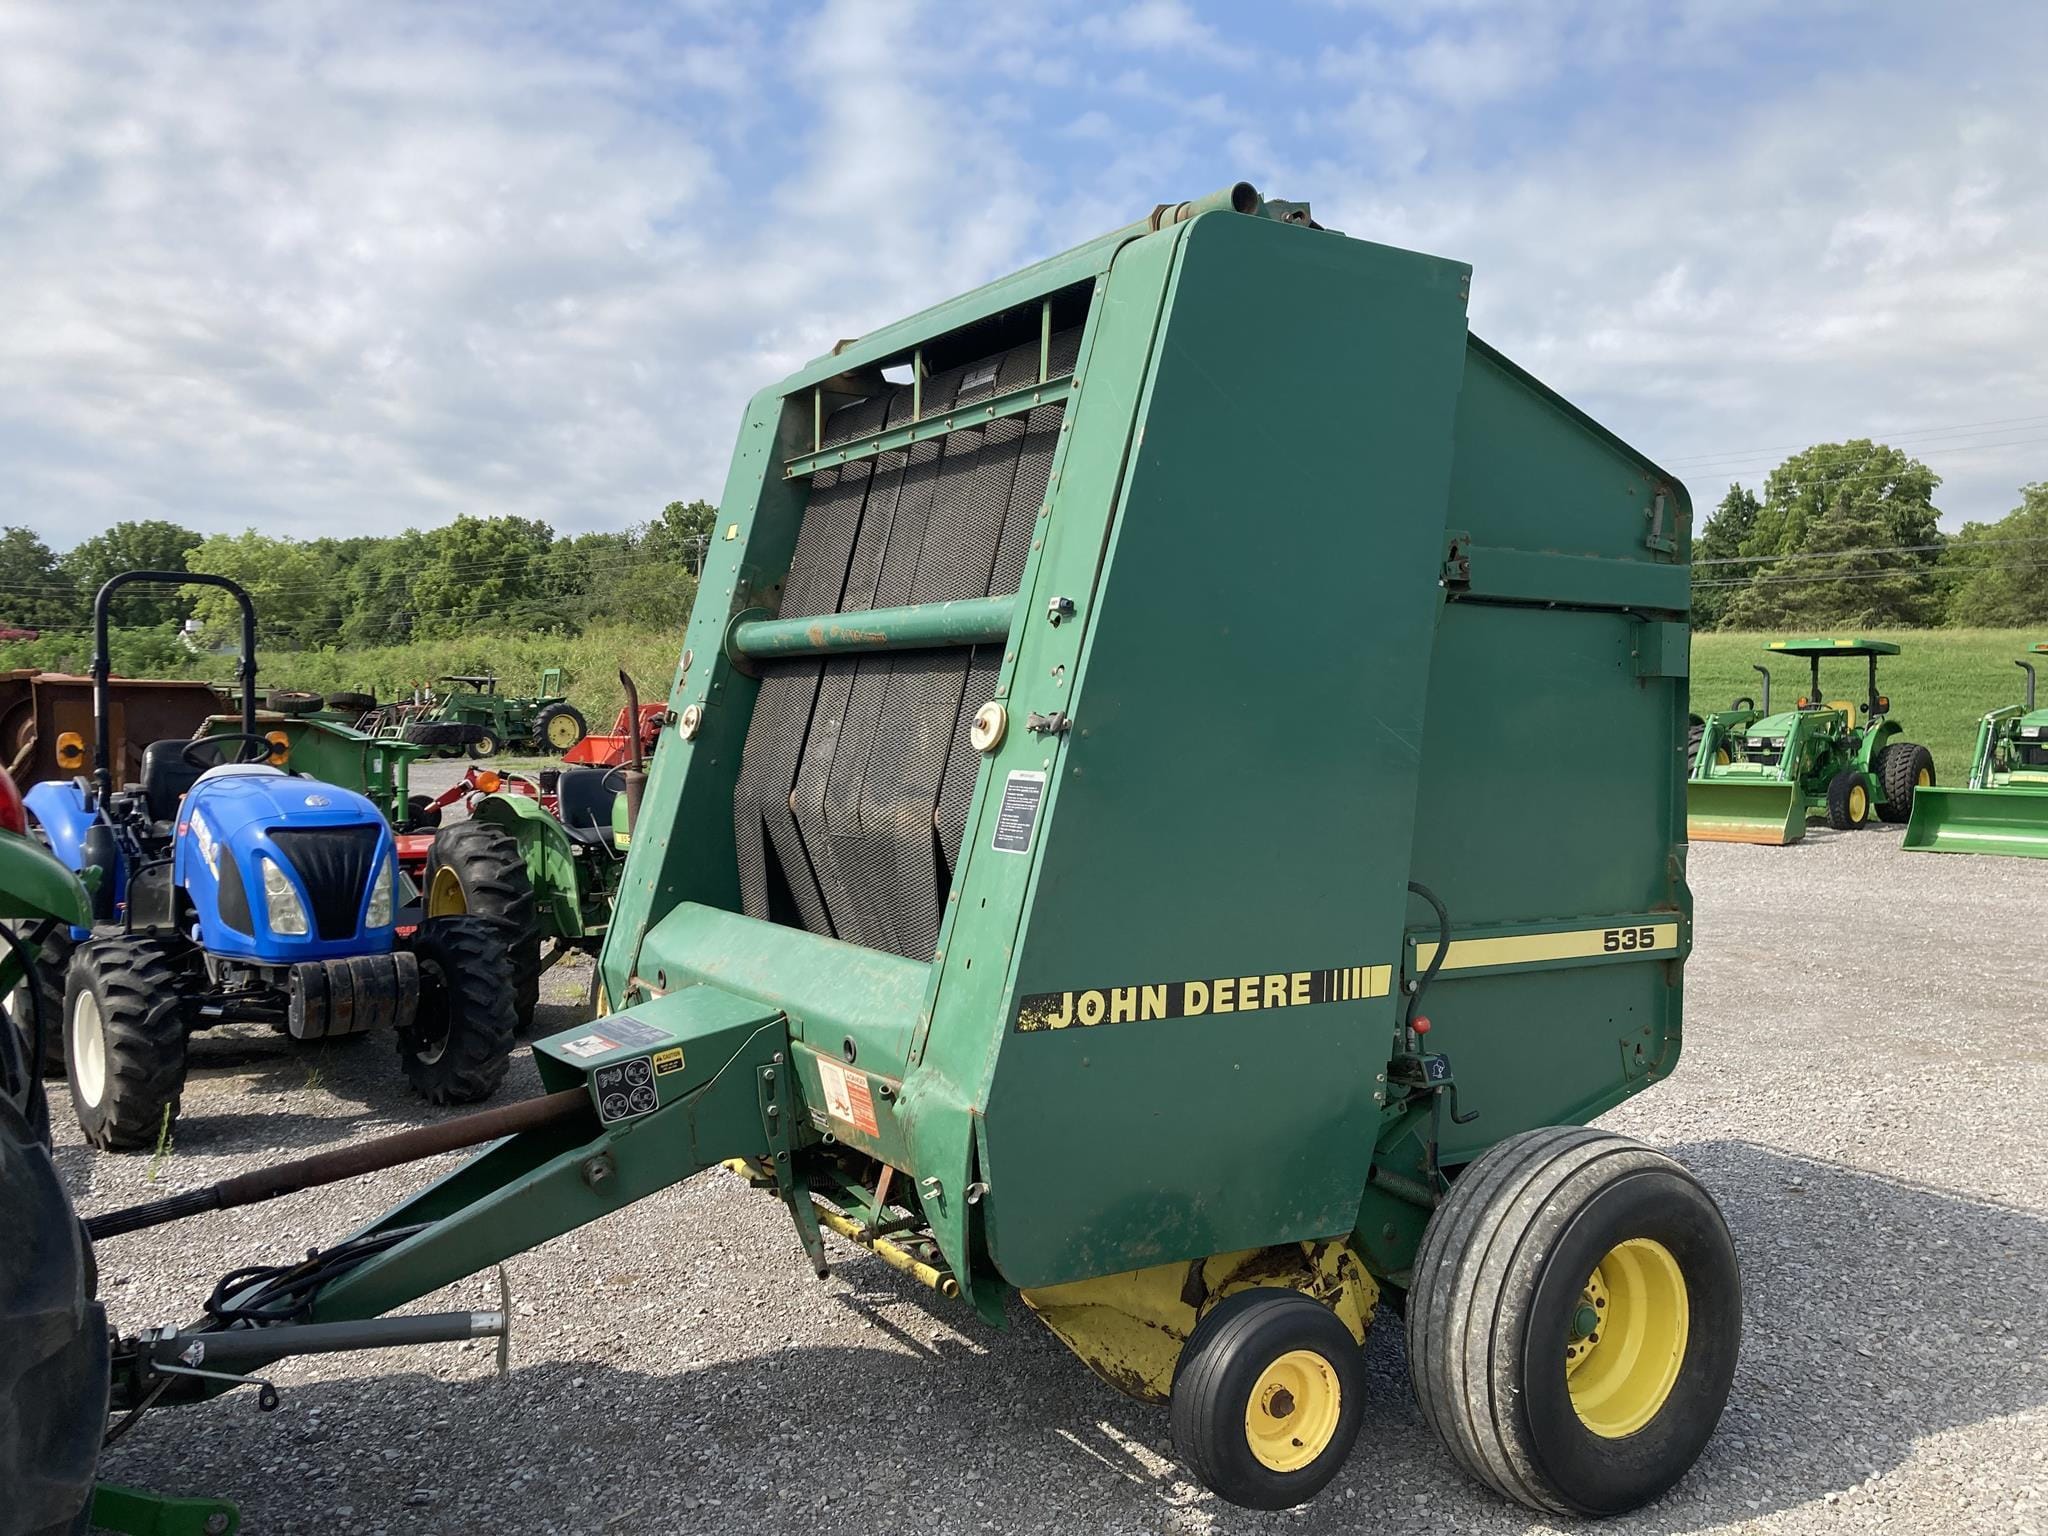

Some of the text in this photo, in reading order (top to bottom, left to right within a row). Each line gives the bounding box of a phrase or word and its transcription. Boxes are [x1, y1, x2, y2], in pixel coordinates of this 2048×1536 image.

[1603, 927, 1655, 952] 535
[1048, 972, 1312, 1029] JOHN DEERE
